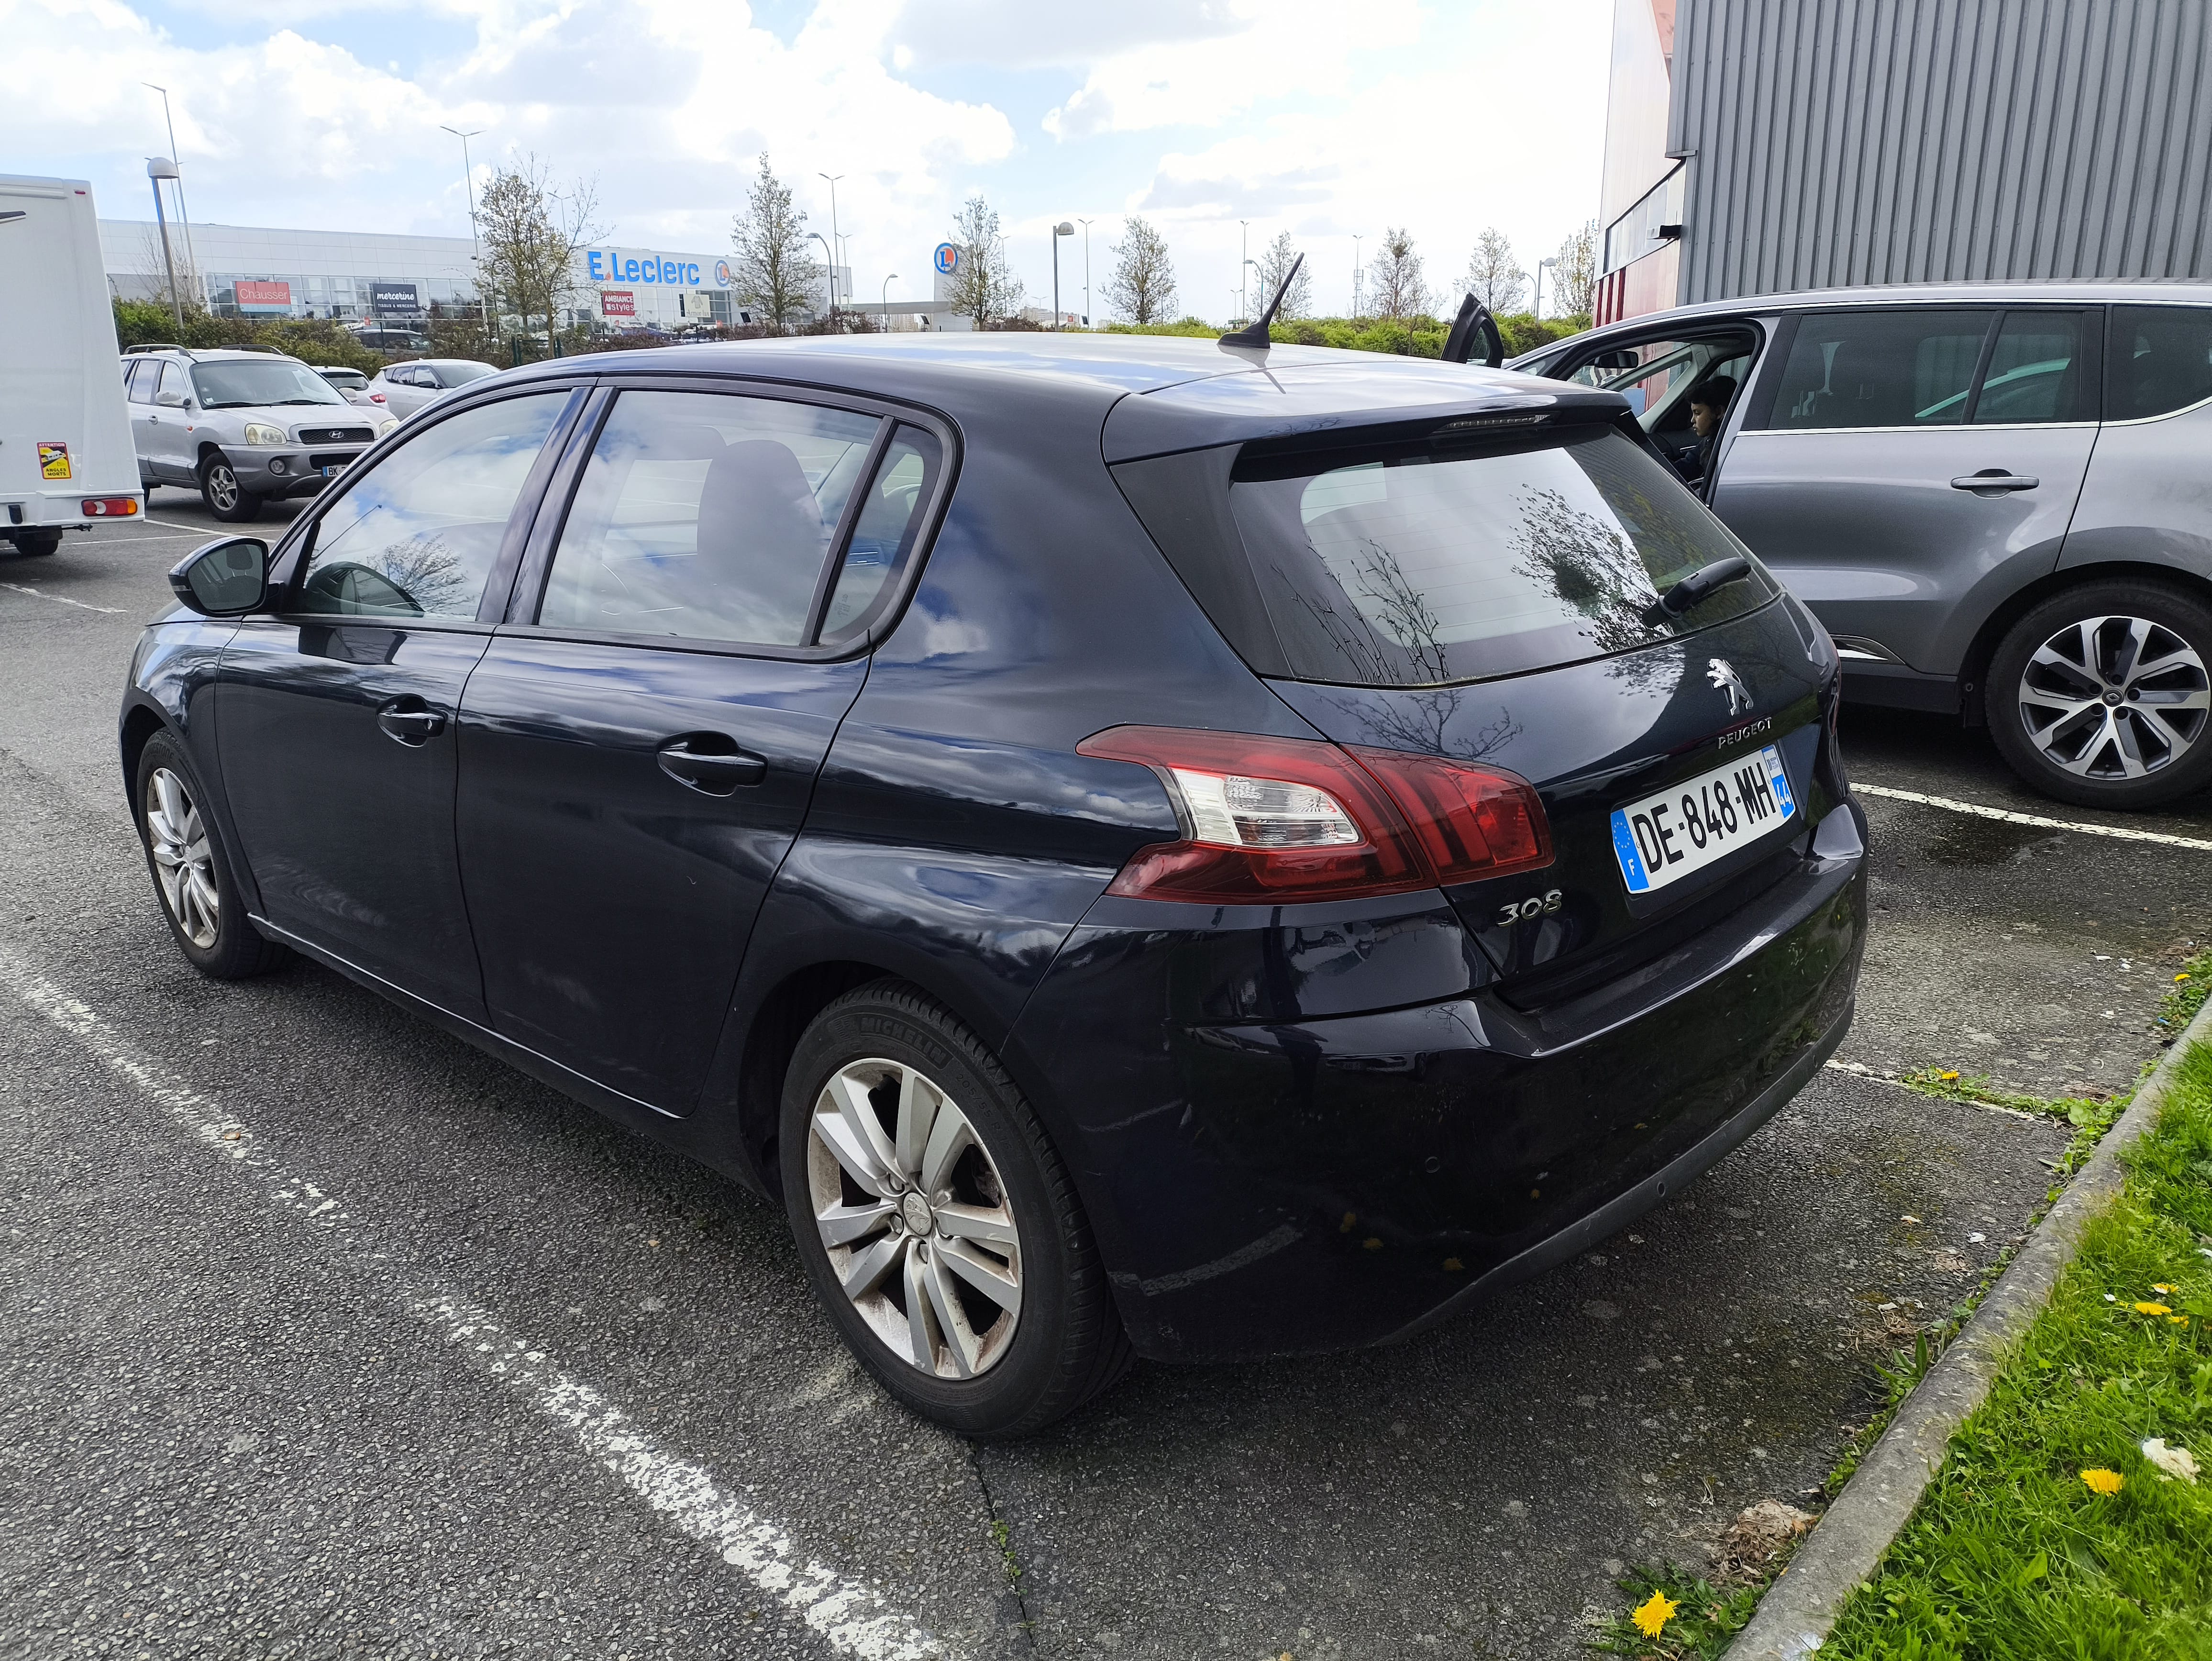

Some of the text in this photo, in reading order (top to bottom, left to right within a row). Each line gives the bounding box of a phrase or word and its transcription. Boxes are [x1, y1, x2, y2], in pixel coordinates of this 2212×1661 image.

[587, 251, 699, 285] E.Leclerc
[240, 288, 287, 299] Chausser
[376, 291, 415, 300] mercerine
[611, 303, 634, 312] styles
[1718, 717, 1771, 749] PEUGEOT
[1777, 781, 1792, 808] 44
[1632, 762, 1776, 874] DE-848-MH
[1627, 858, 1635, 876] F
[1497, 889, 1562, 928] 308
[861, 1017, 946, 1065] MICHELIN
